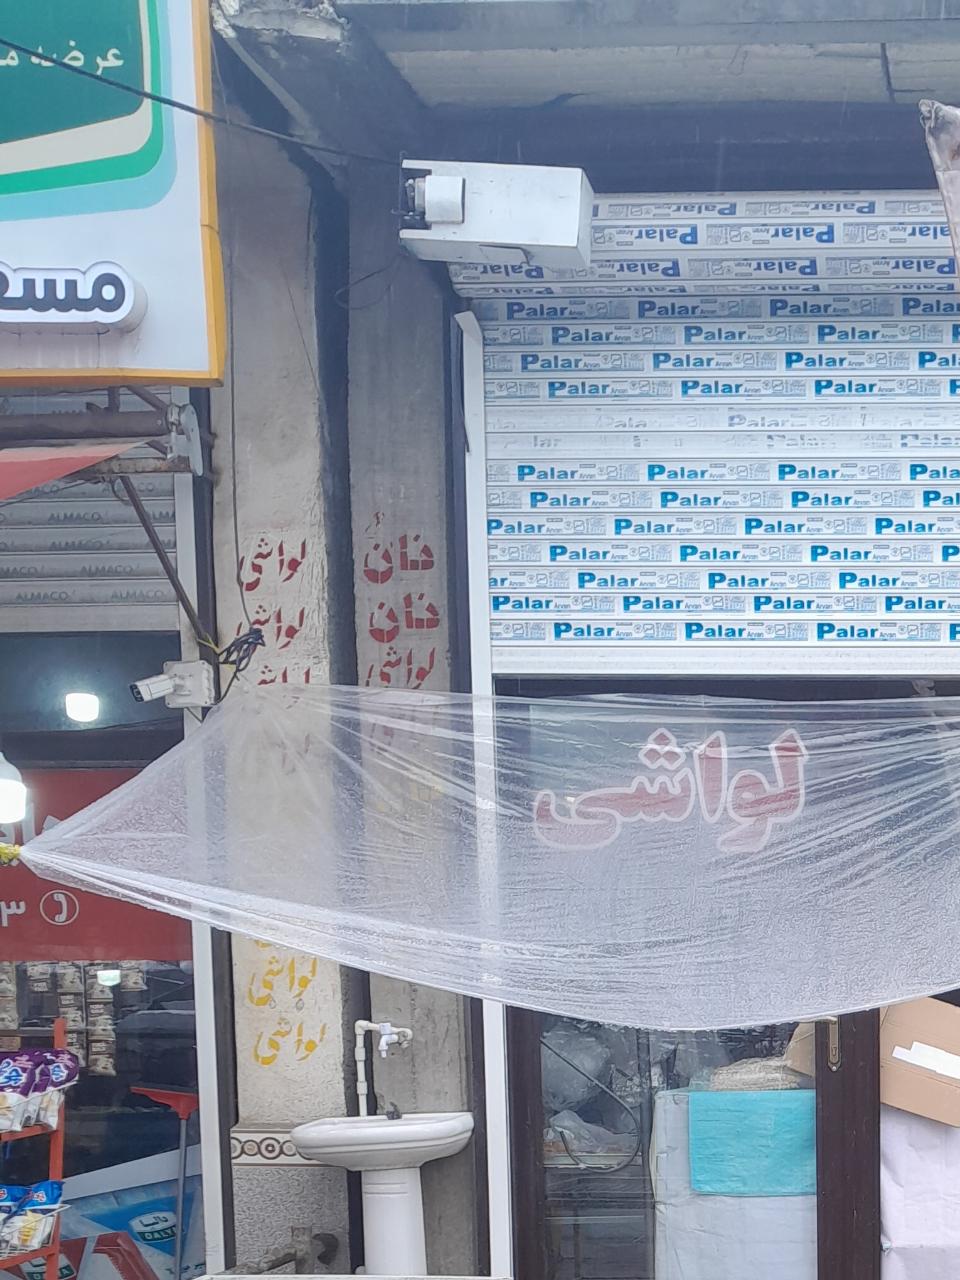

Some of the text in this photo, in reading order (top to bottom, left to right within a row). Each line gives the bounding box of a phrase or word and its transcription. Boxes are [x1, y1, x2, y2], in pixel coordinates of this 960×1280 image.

[907, 223, 950, 238] alar
[506, 302, 568, 320] Palar
[638, 301, 699, 319] Palar
[770, 299, 831, 317] Palar
[552, 327, 613, 344] Palar
[684, 326, 746, 344] Palar
[817, 325, 880, 343] Palar
[521, 354, 582, 371] Palar
[653, 353, 714, 369] Palar
[785, 352, 846, 369] Palar
[548, 382, 610, 398] Palar
[681, 380, 743, 396] Palar
[814, 379, 876, 395] Palar
[517, 465, 578, 481] Palar
[647, 464, 709, 480] Palar
[778, 463, 839, 480] Palar
[530, 491, 591, 508] Palar
[660, 491, 721, 508] Palar
[791, 491, 852, 508] Palar
[487, 519, 546, 535] Palar
[614, 518, 675, 535] Palar
[744, 518, 805, 535] Palar
[875, 518, 936, 535] Palar
[549, 545, 610, 562] Palar
[679, 545, 740, 562] Palar
[810, 545, 871, 562] Palar
[0, 566, 38, 576] MACO
[578, 572, 638, 589] Palar
[708, 572, 769, 589] Palar
[838, 572, 900, 589] Palar
[492, 596, 553, 611] Palar
[623, 596, 683, 611] Palar
[753, 595, 815, 611] Palar
[885, 595, 946, 611] Palar
[554, 622, 615, 639] Palar
[685, 622, 746, 639] Palar
[816, 622, 878, 640] Palar
[533, 727, 809, 852] لواشی
